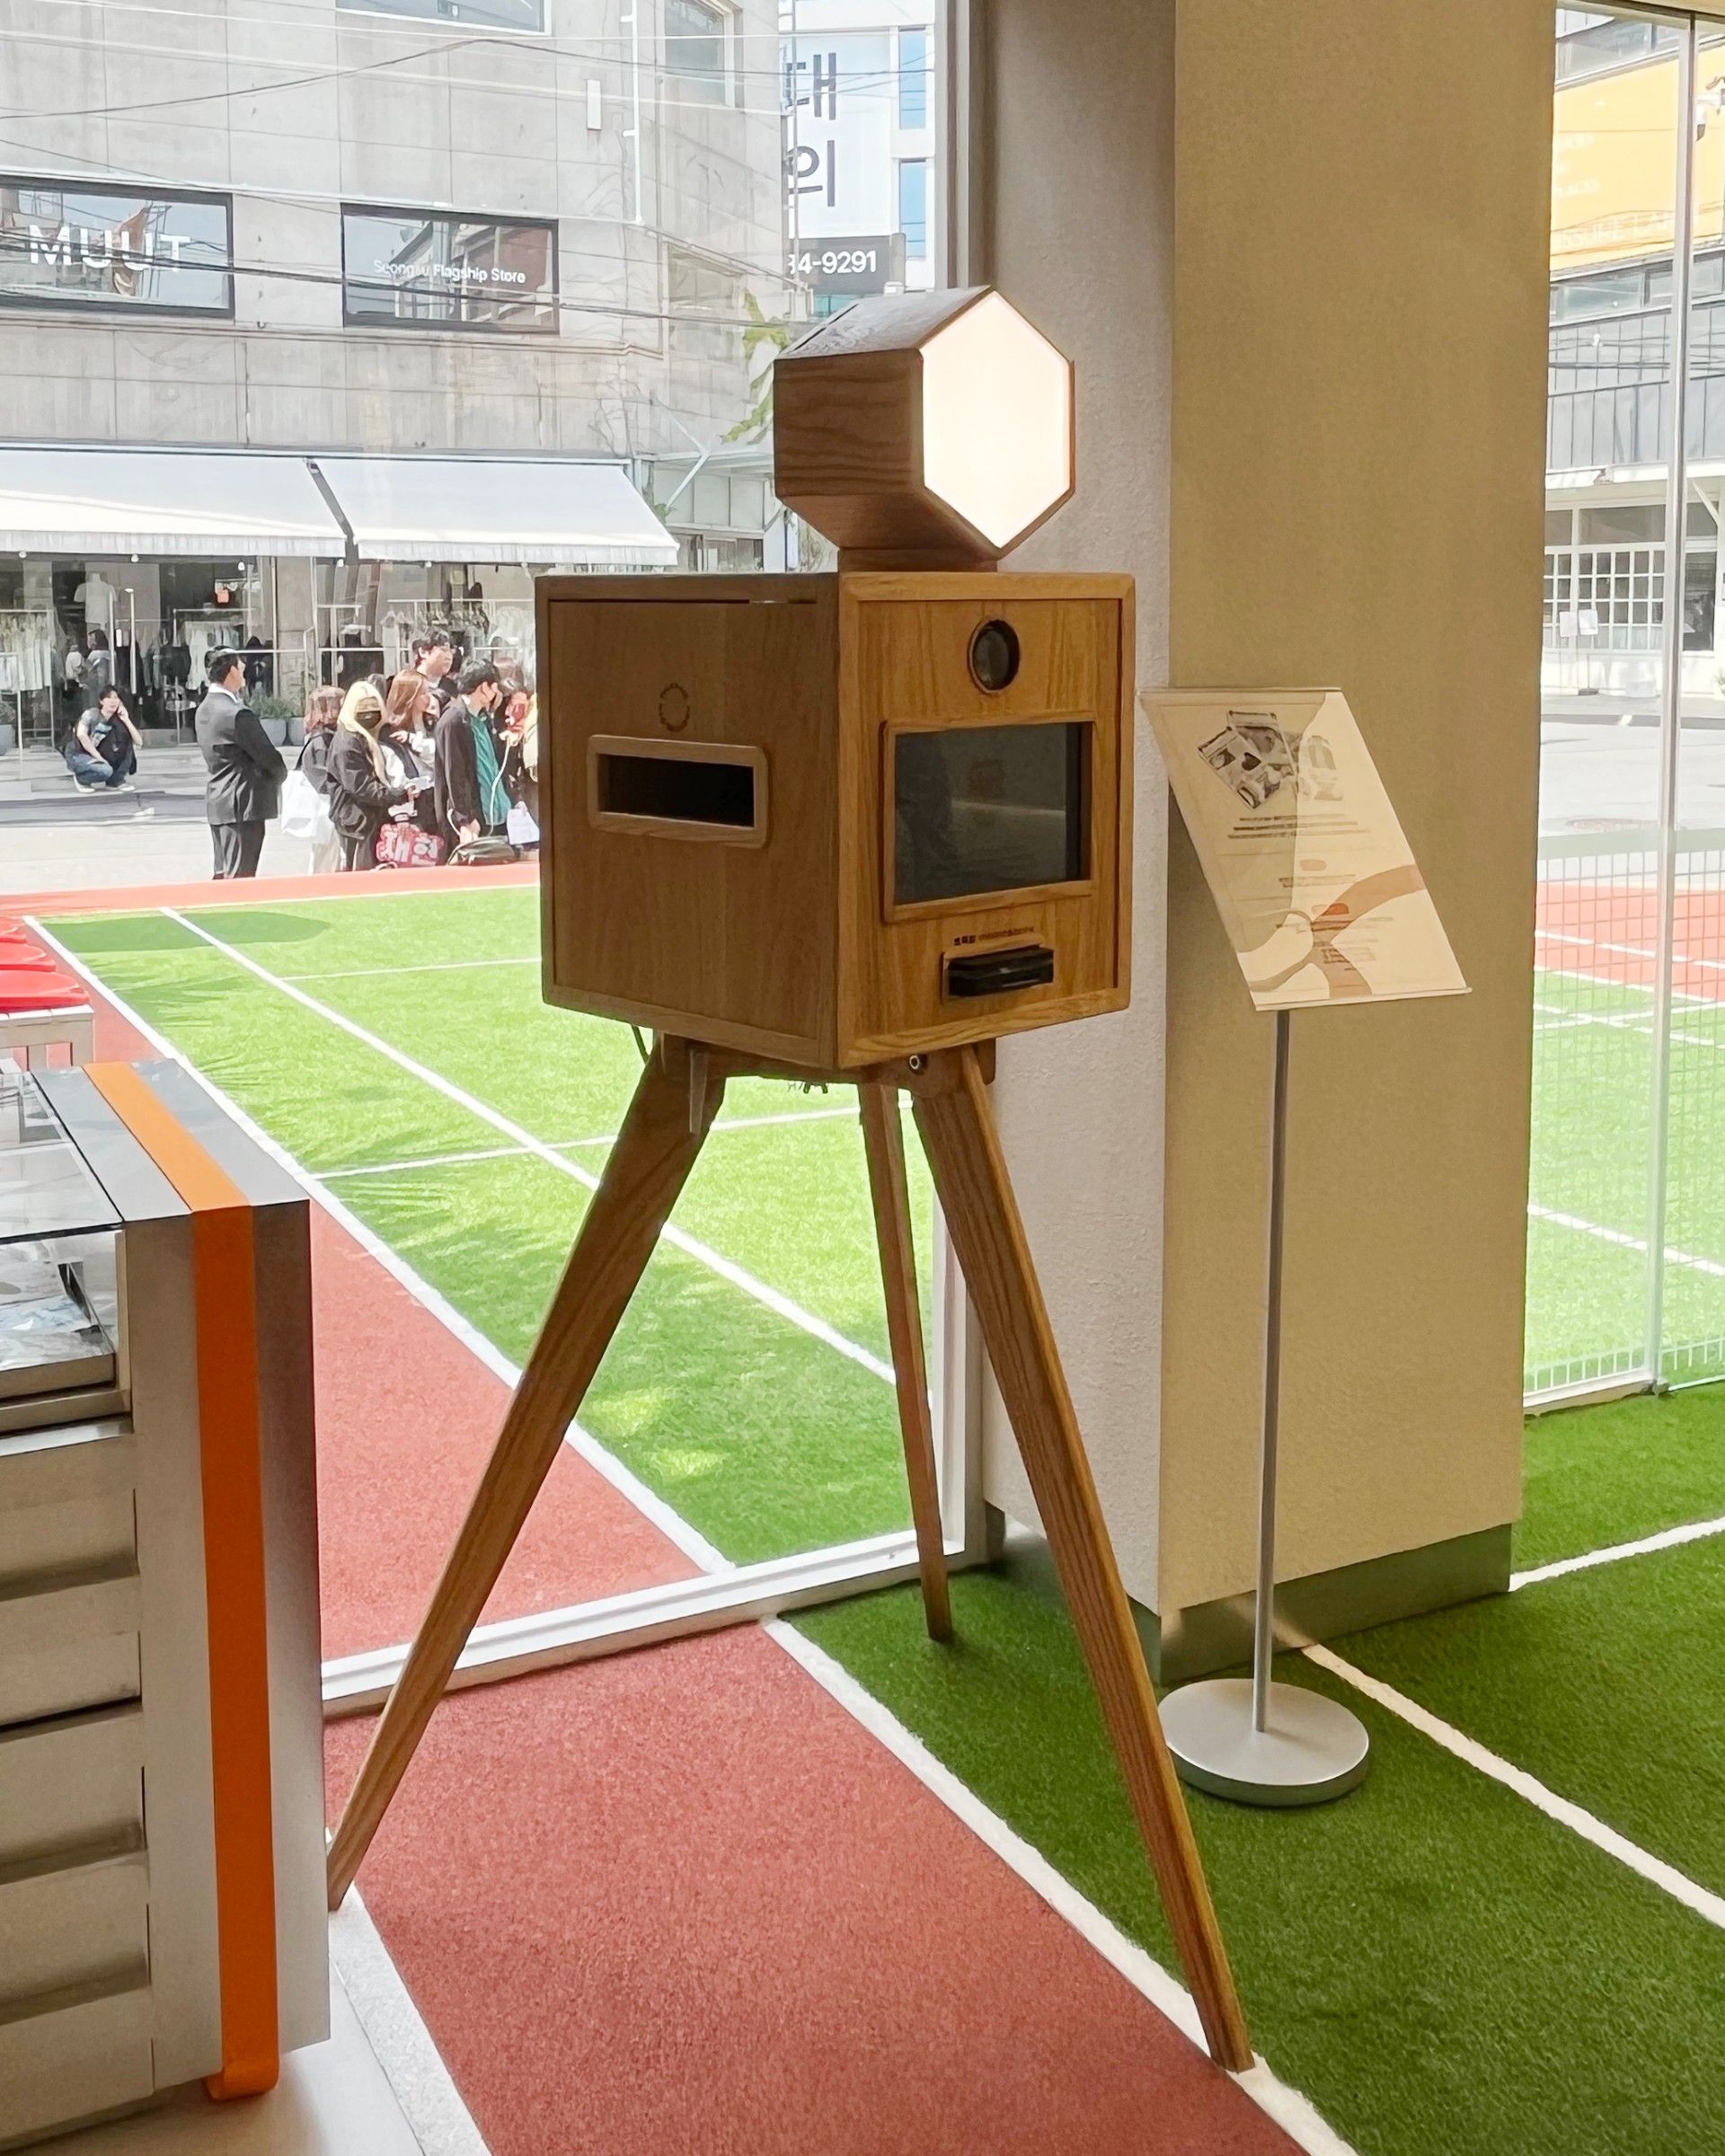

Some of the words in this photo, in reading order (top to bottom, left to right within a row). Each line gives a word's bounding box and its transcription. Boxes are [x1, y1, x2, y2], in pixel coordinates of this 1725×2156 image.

[30, 225, 191, 272] MUUT
[433, 264, 488, 283] Flagship
[491, 269, 526, 284] Store
